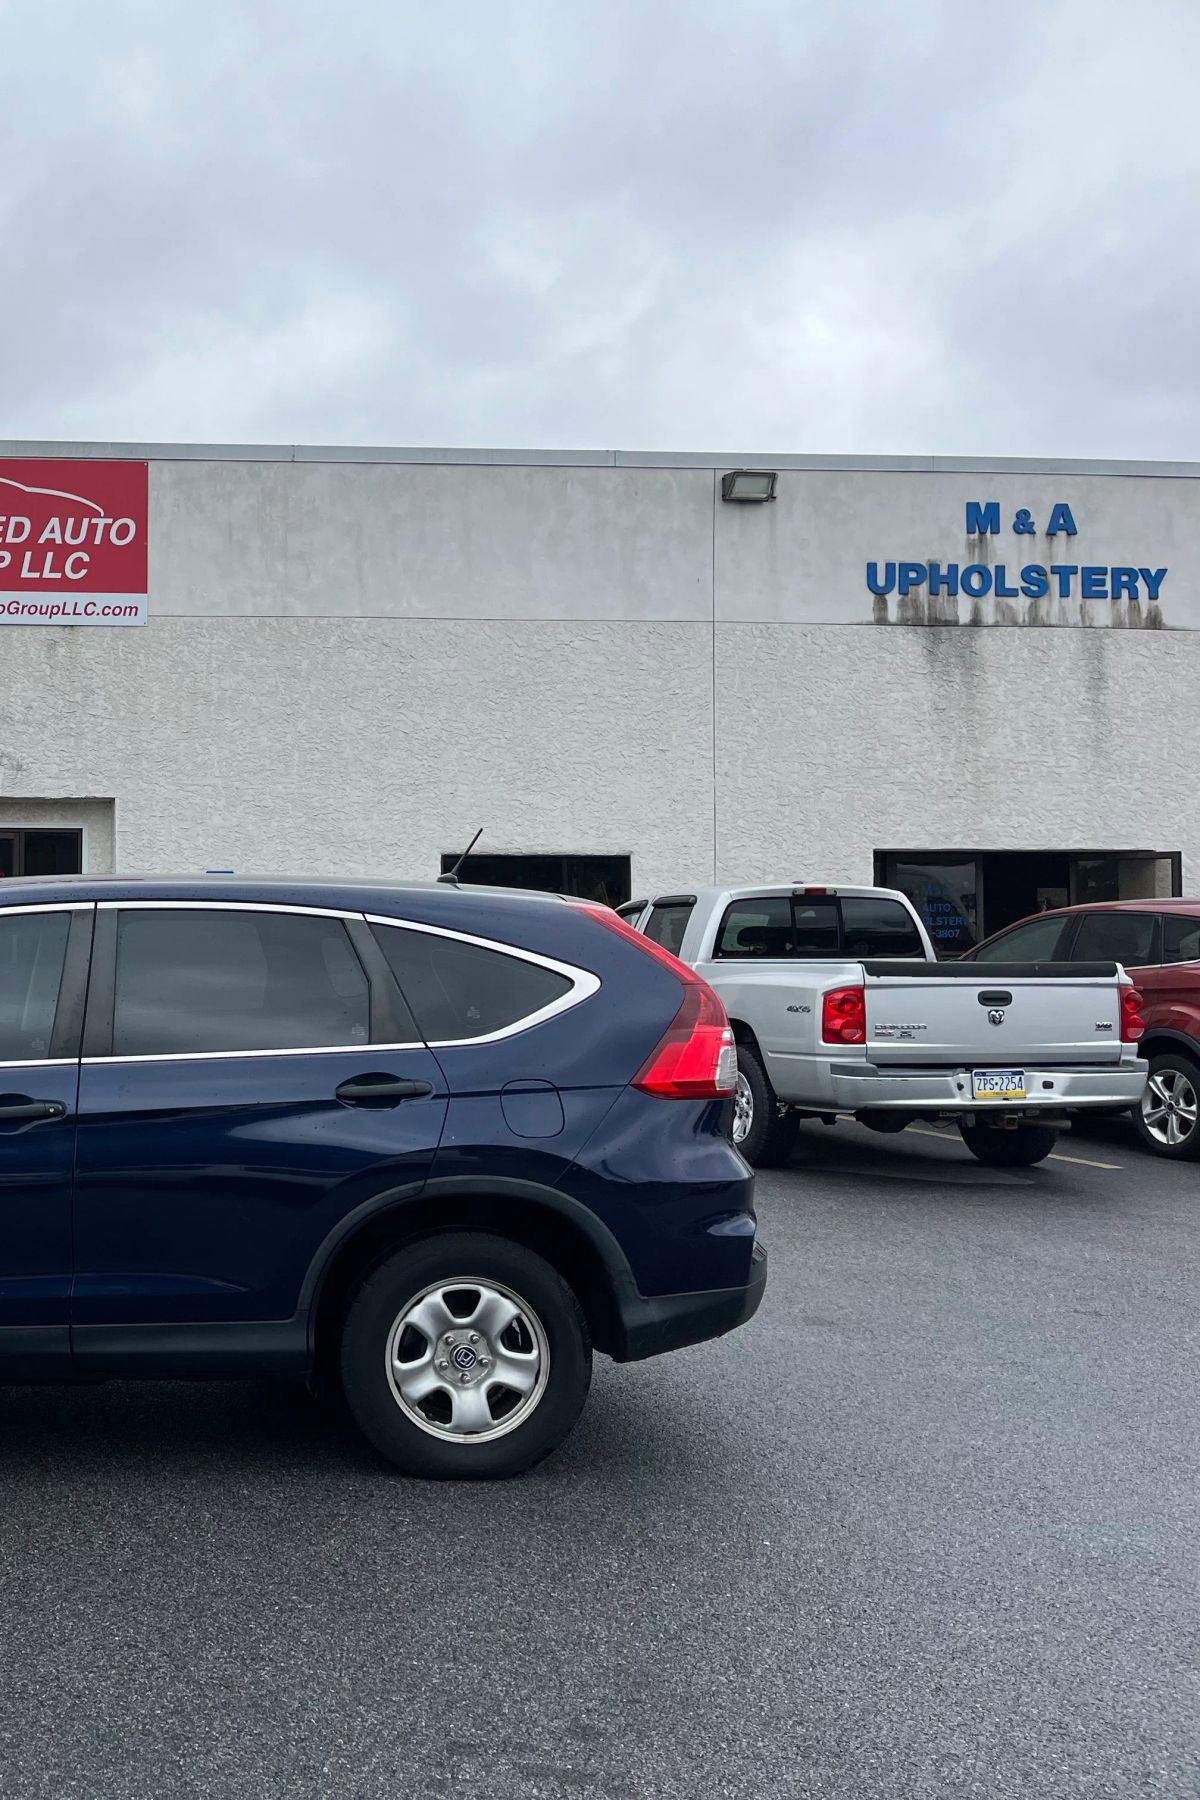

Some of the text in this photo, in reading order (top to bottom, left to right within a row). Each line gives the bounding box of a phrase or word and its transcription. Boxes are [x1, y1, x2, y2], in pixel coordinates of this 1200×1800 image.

[37, 517, 136, 545] AUTO
[966, 502, 1078, 536] M & A
[20, 551, 90, 579] LLC
[866, 562, 1168, 600] UPHOLSTERY
[922, 903, 952, 913] AUTO
